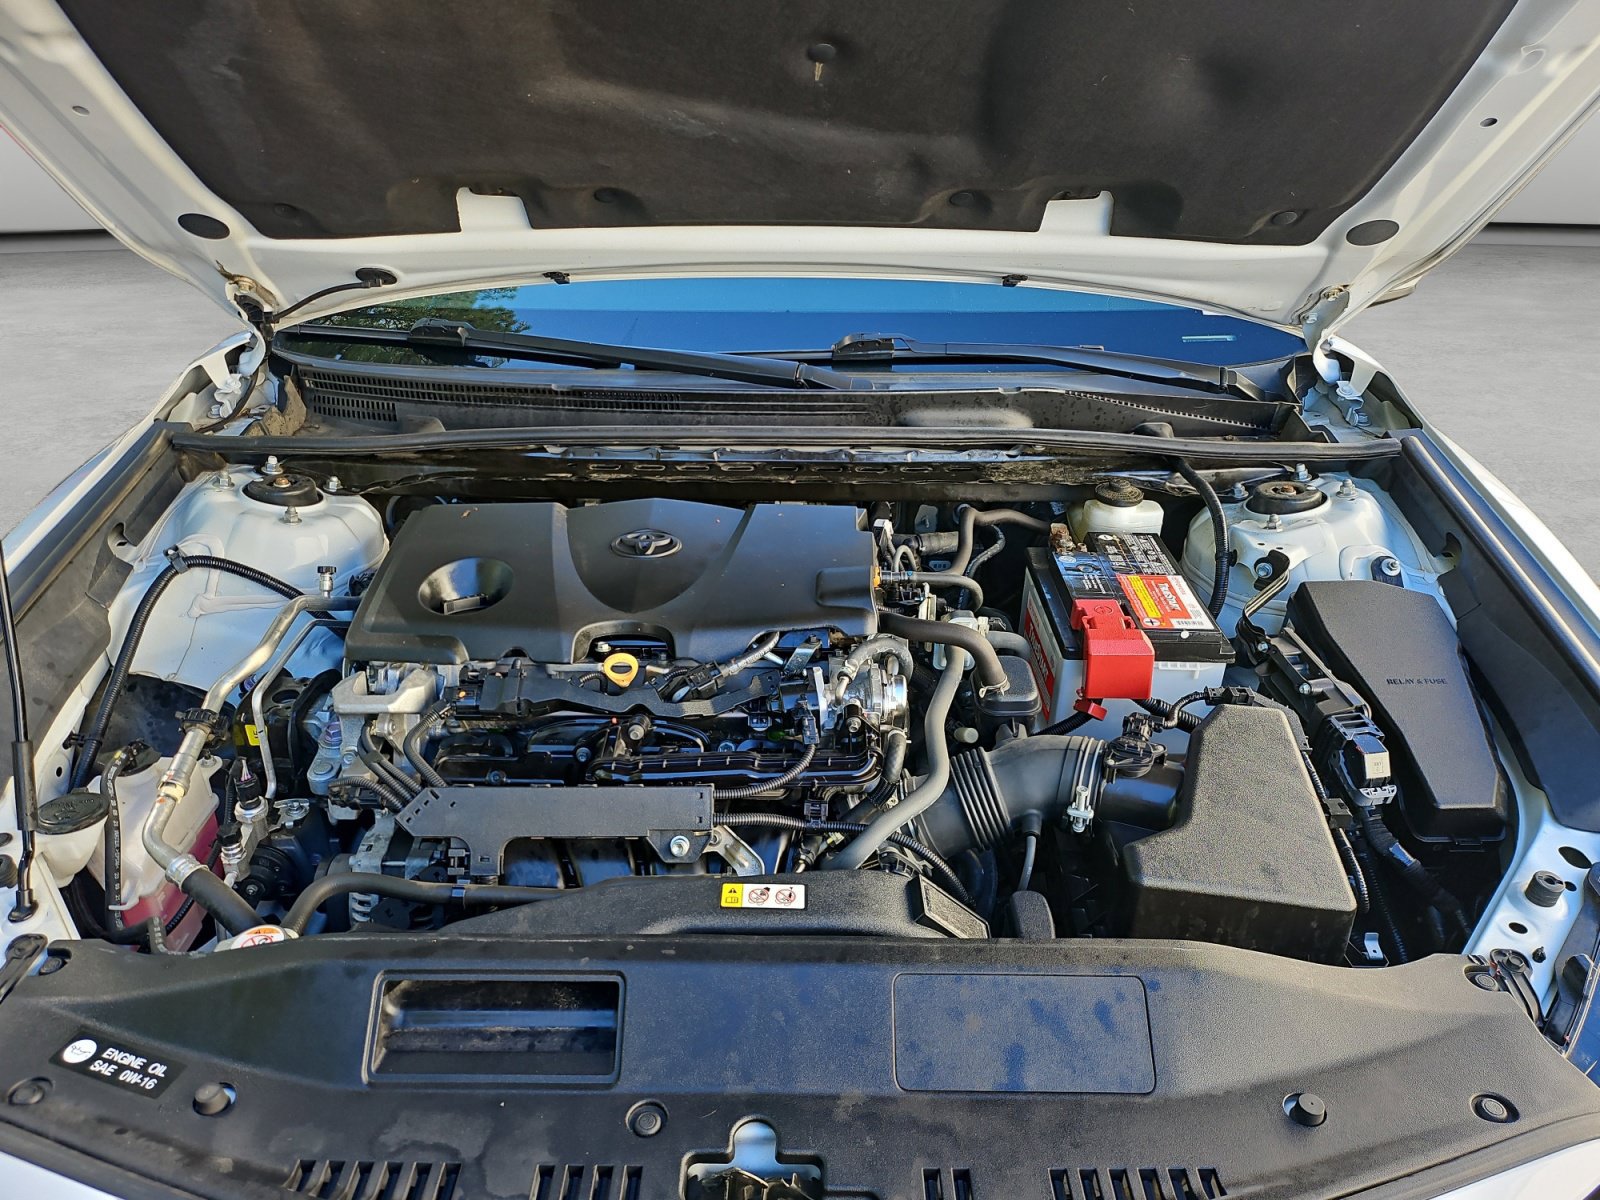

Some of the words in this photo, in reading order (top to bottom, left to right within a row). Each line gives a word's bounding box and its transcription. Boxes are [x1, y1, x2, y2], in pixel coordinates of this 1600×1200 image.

[1423, 677, 1448, 685] FUSE
[89, 1059, 119, 1077] SAE
[101, 1047, 147, 1070] ENGINE
[147, 1062, 168, 1078] OIL
